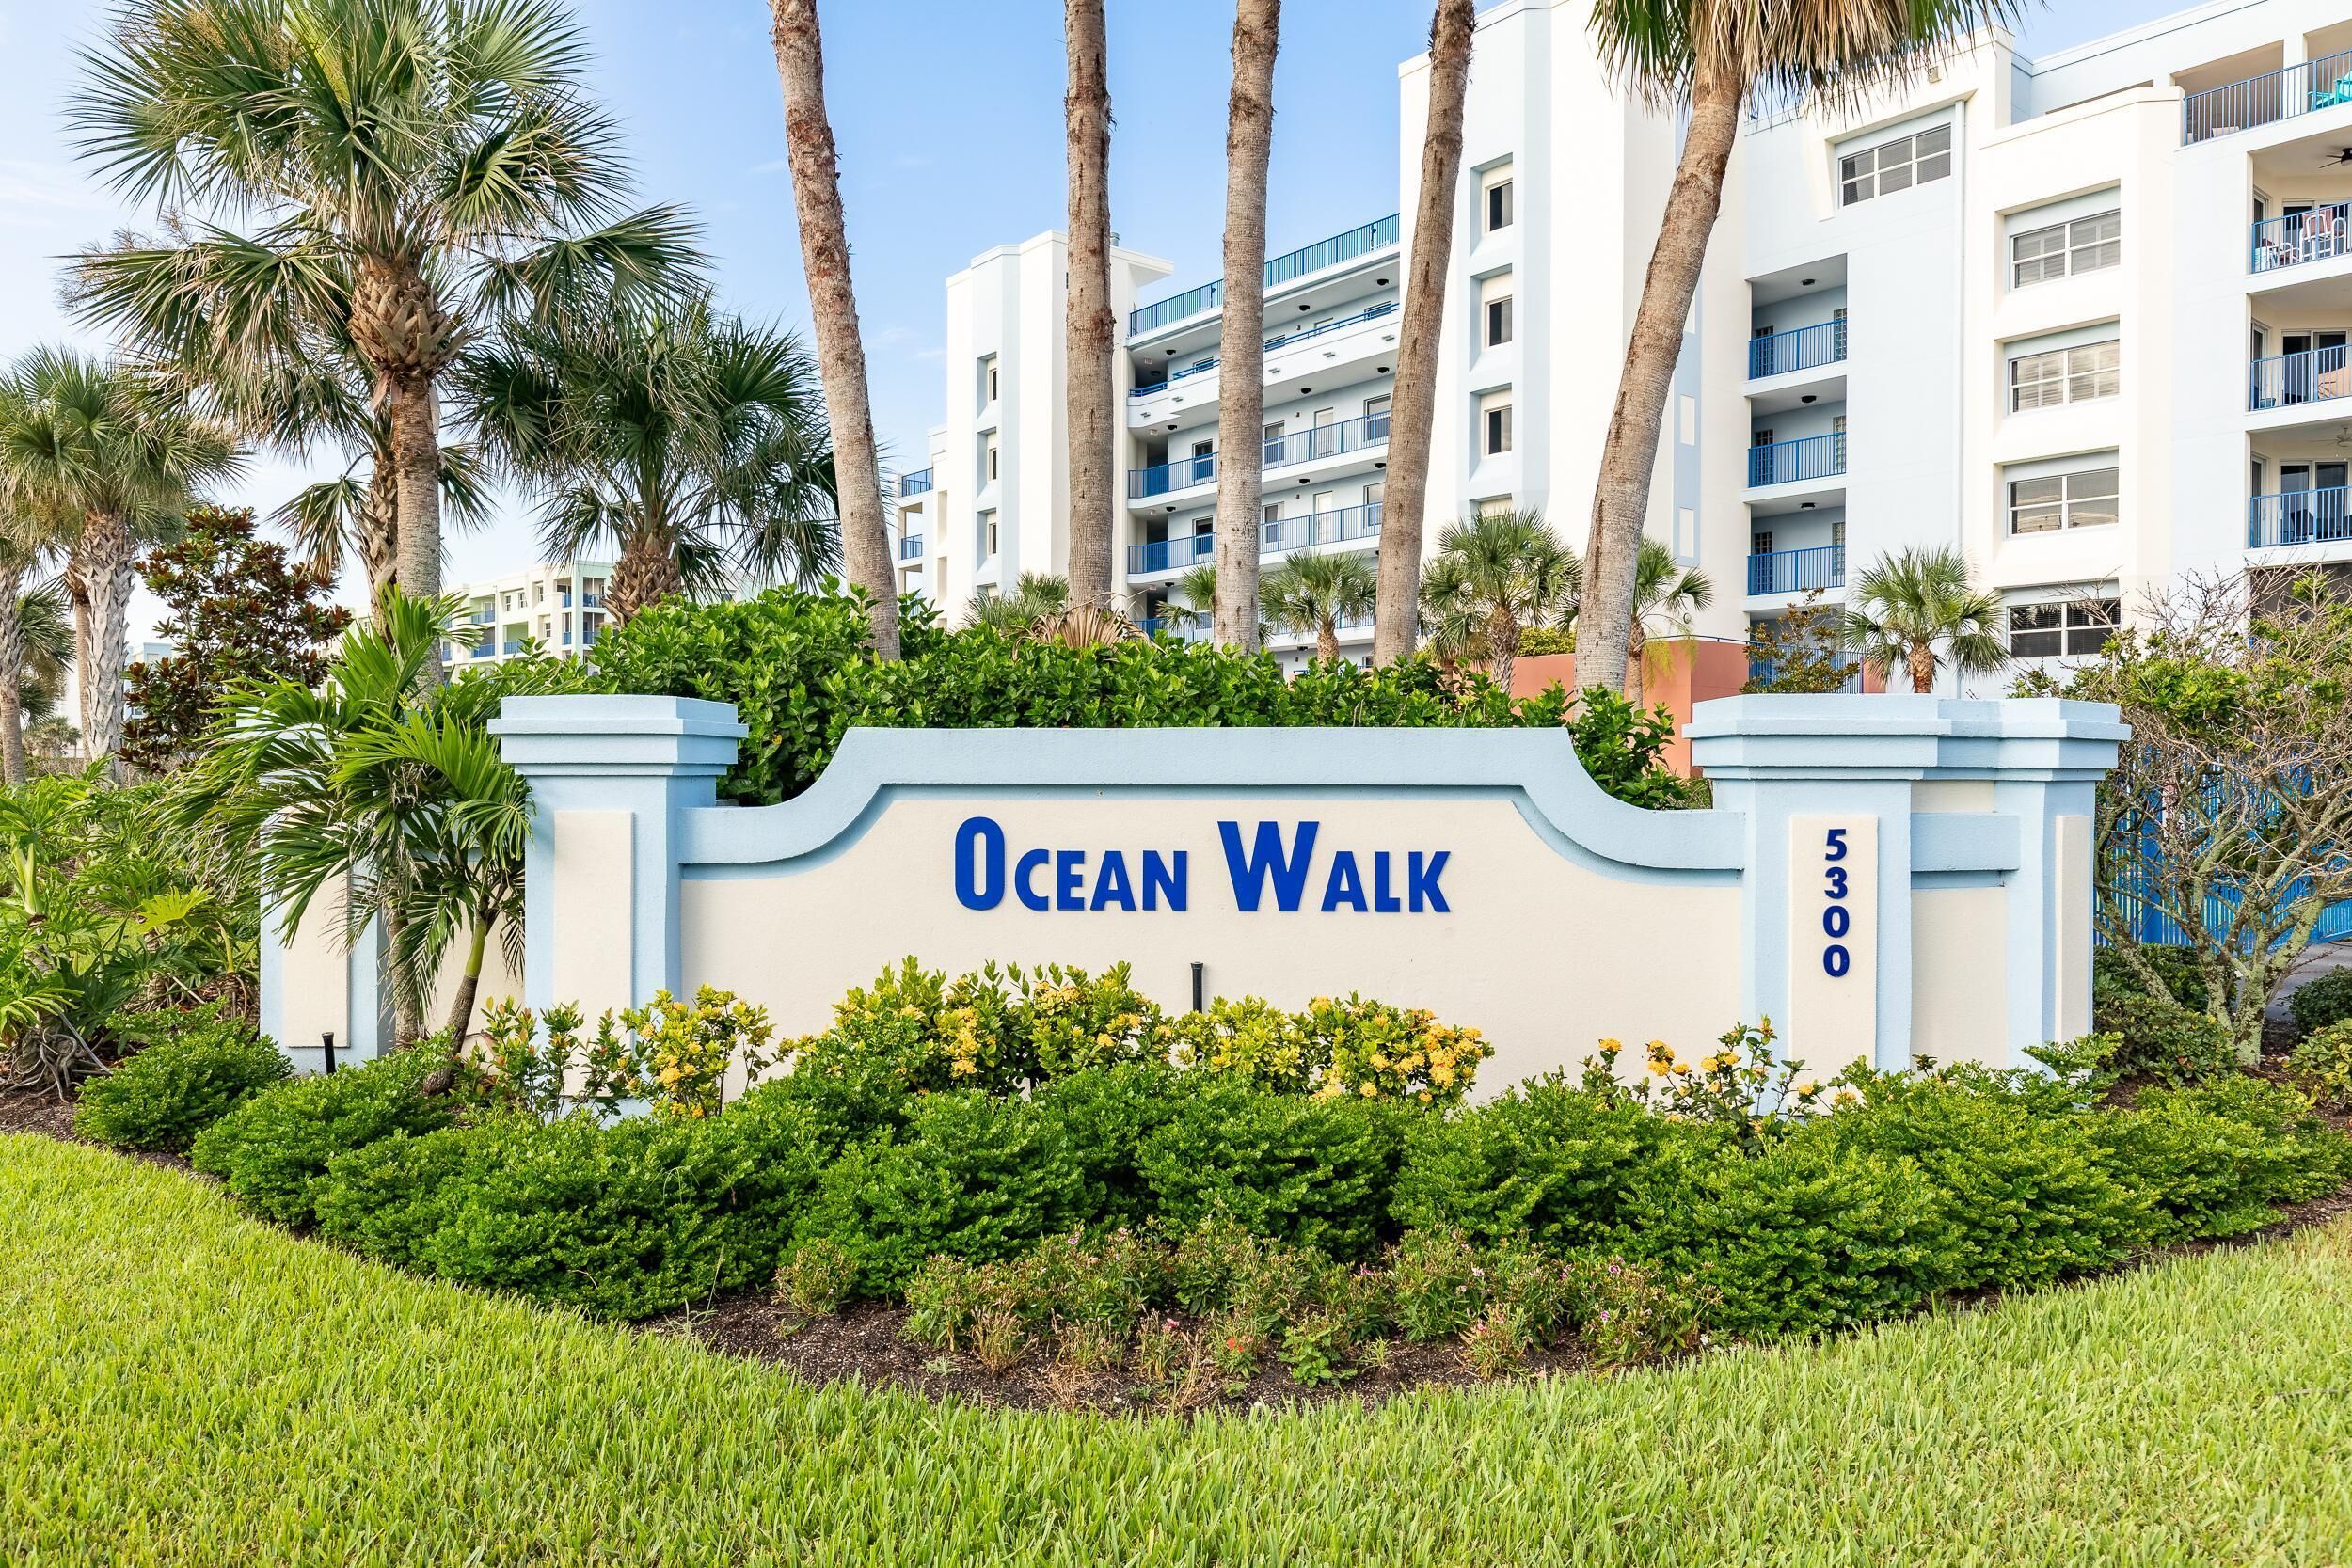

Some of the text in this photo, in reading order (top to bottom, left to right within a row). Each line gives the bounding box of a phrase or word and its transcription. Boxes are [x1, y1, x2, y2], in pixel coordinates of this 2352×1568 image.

[955, 816, 1452, 913] OCEAN WALK
[1822, 828, 1851, 978] 5300
